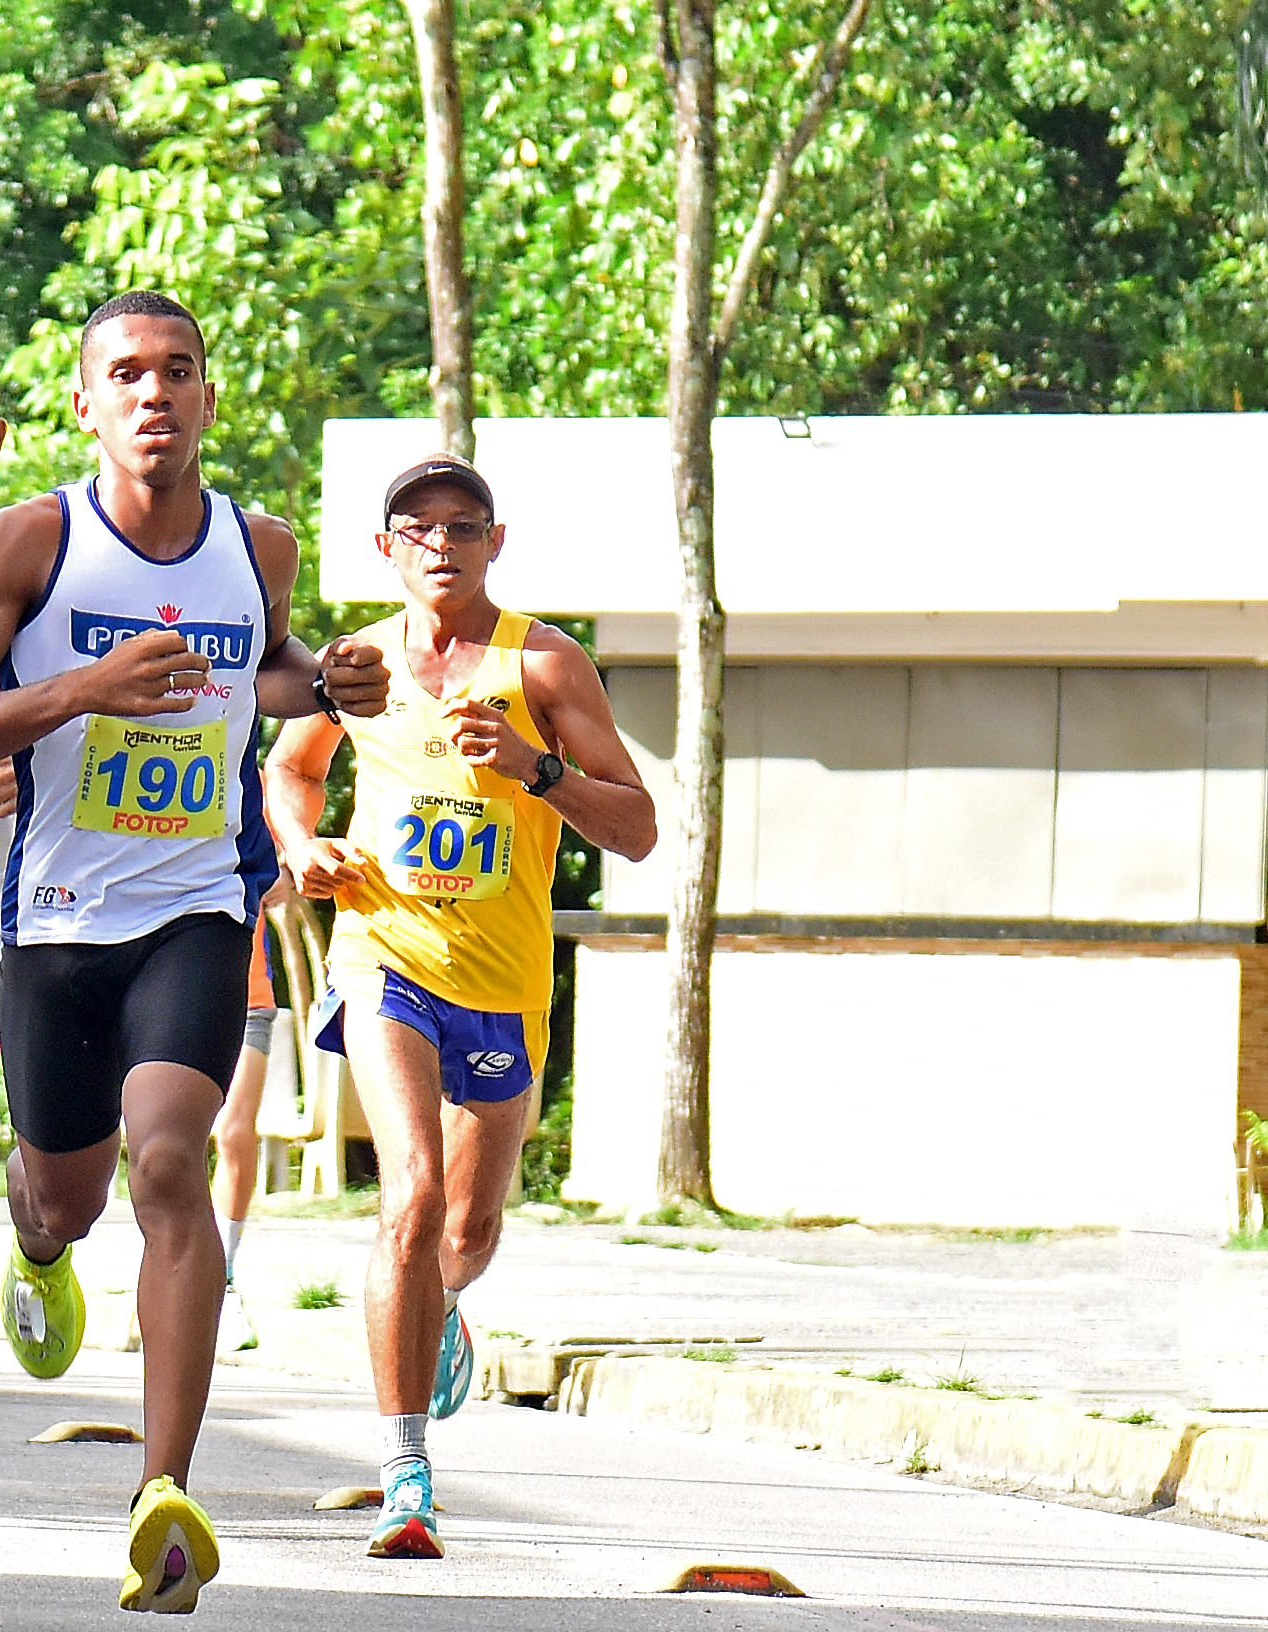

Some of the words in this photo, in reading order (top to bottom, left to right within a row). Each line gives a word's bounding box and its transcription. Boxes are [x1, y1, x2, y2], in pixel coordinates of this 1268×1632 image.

[124, 729, 203, 748] MENTHOR
[97, 750, 216, 813] 190
[112, 812, 189, 835] FOTOP
[392, 814, 498, 874] 201
[407, 872, 474, 893] FOTOP
